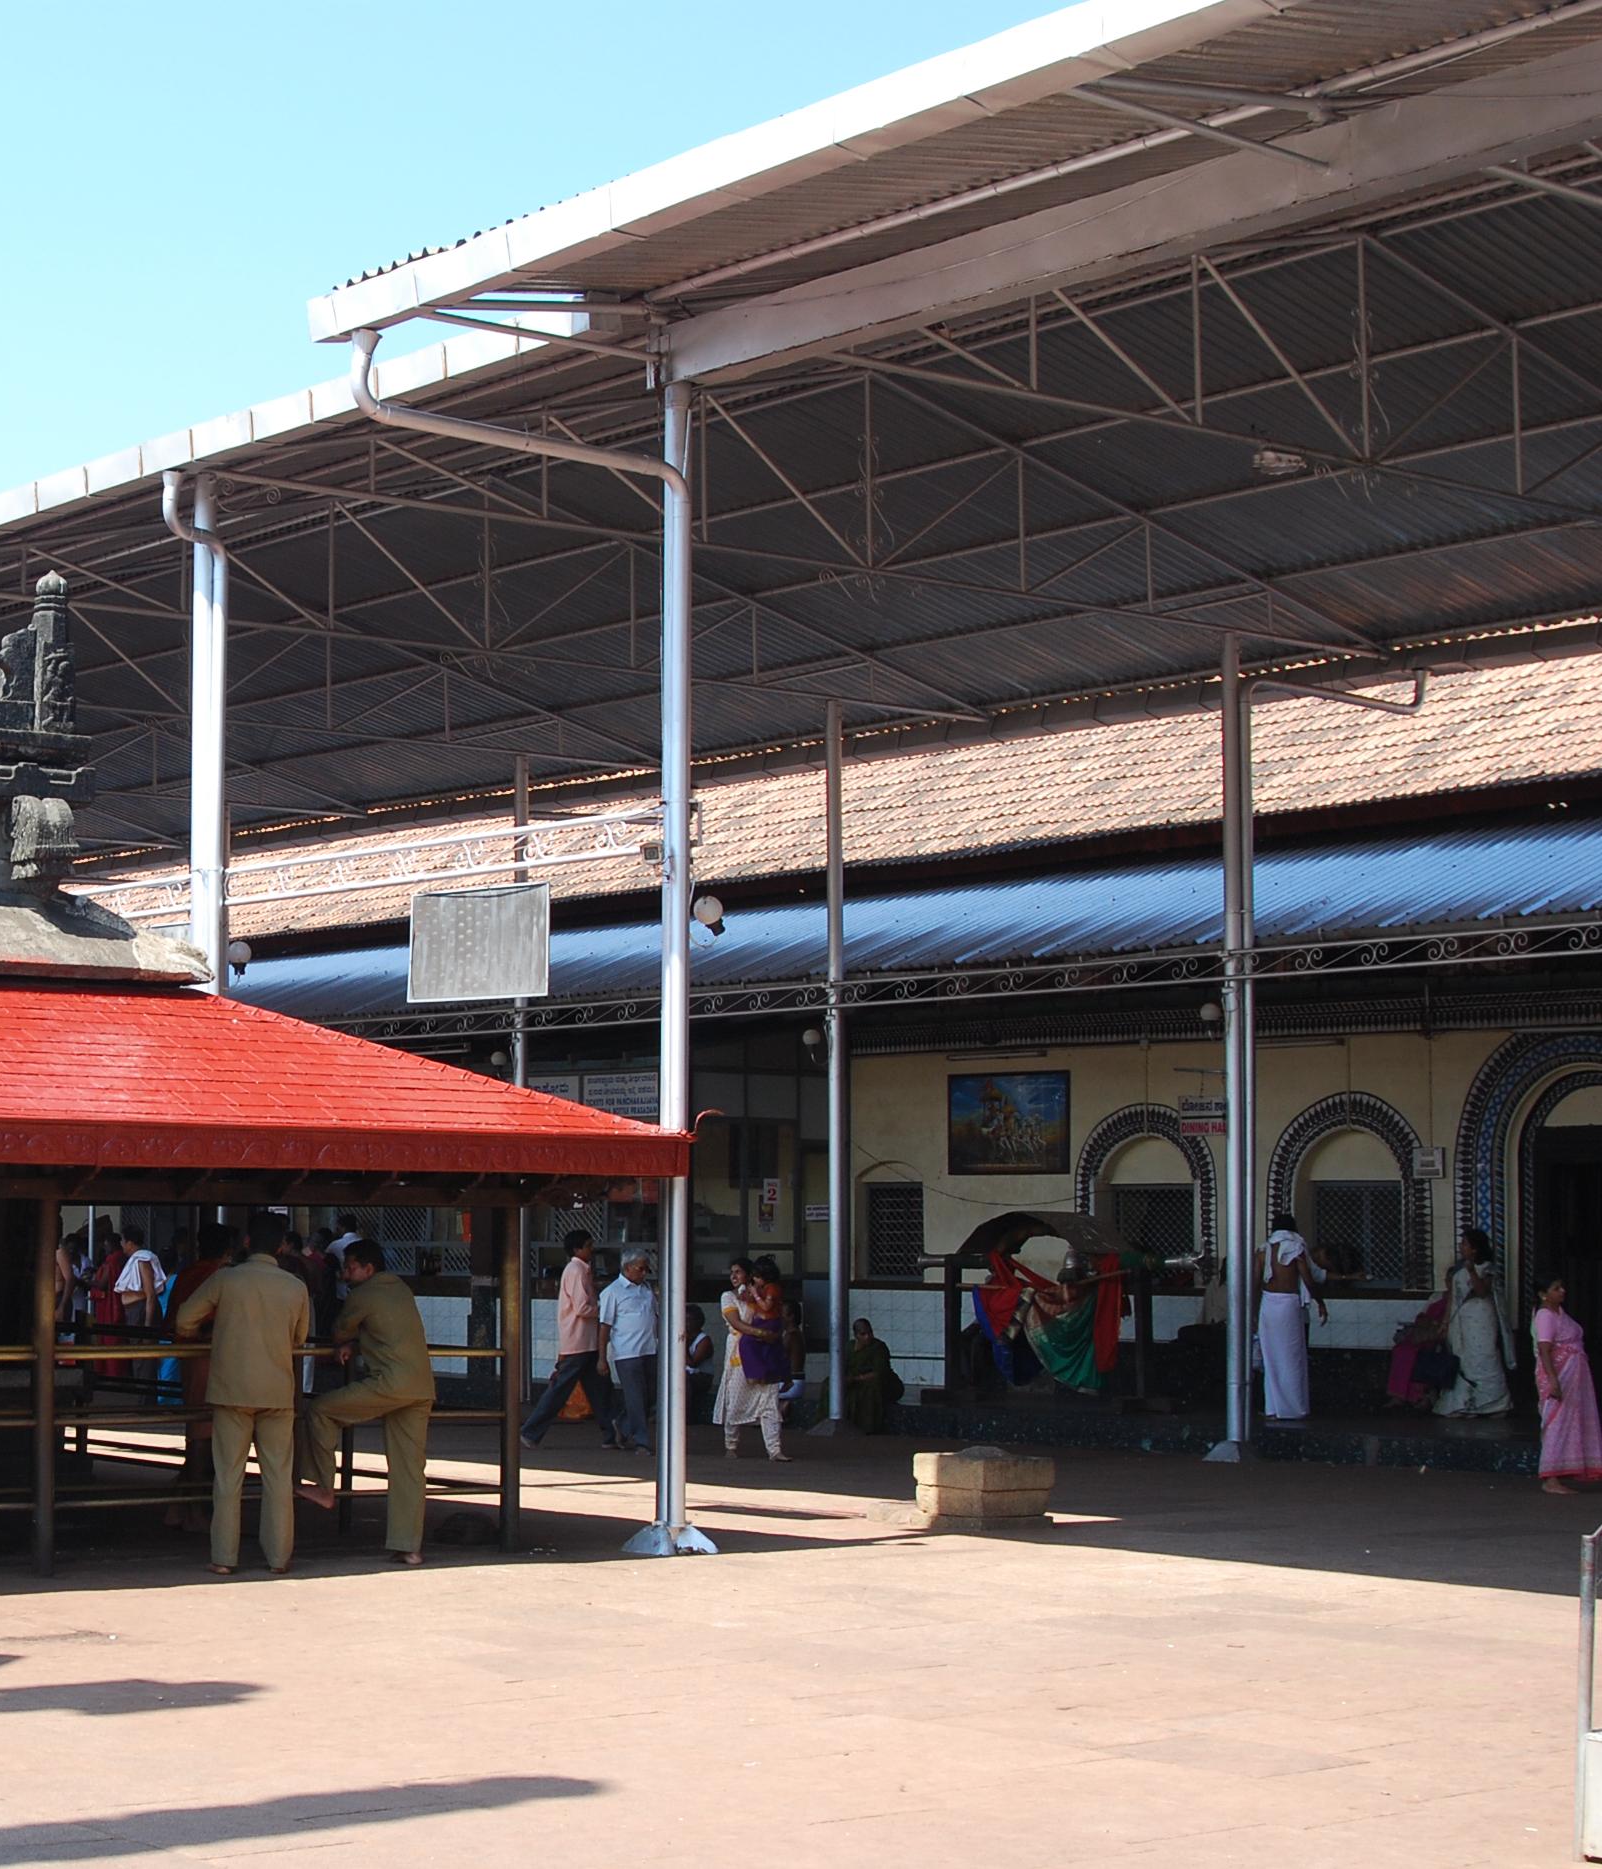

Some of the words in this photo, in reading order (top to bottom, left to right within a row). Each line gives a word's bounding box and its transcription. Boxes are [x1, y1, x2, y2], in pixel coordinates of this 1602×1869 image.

[1181, 1121, 1210, 1133] DINING
[1211, 1121, 1226, 1133] HAL
[767, 1188, 777, 1202] 2
